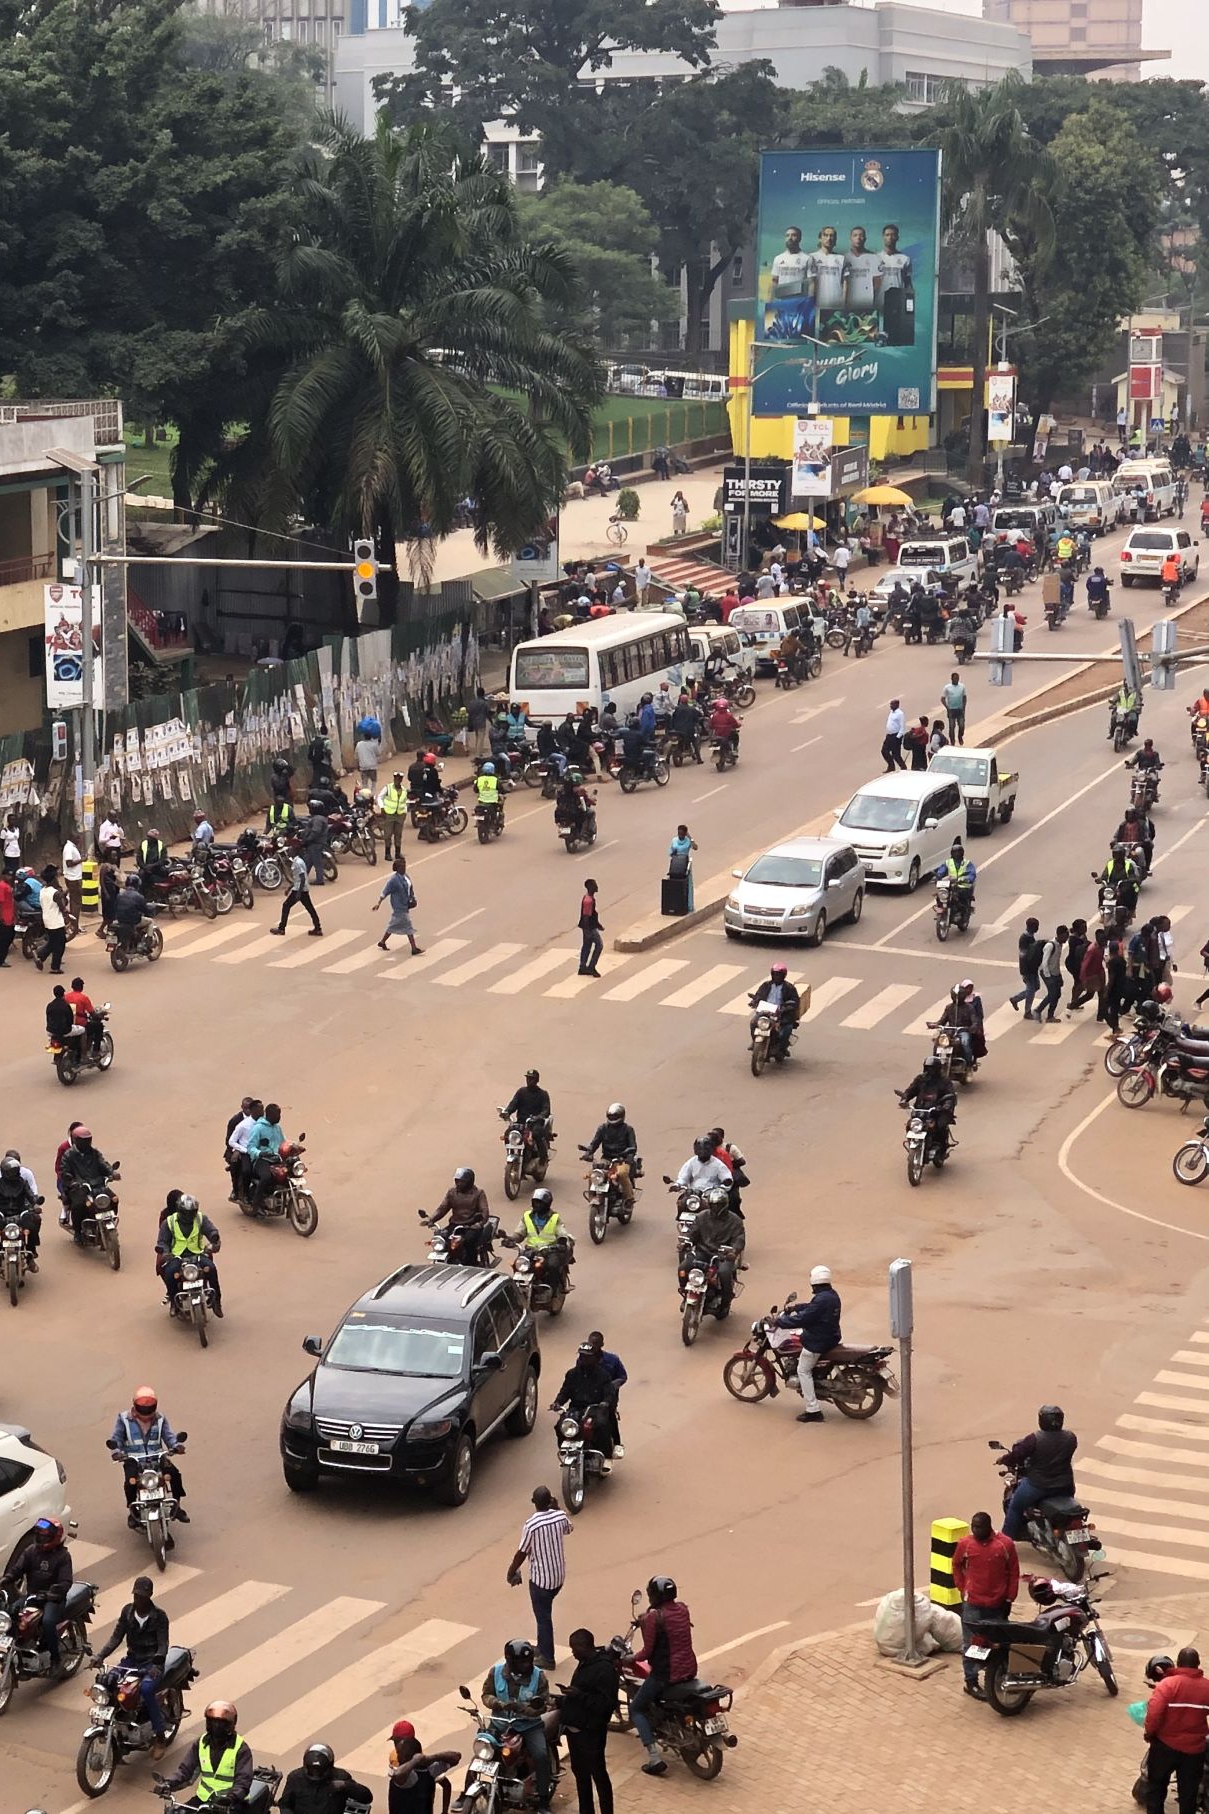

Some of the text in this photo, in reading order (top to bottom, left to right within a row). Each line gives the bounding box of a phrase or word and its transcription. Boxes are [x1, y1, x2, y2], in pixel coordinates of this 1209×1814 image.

[800, 172, 846, 182] Hisense
[835, 361, 878, 385] Glory
[726, 479, 782, 490] THRSTY
